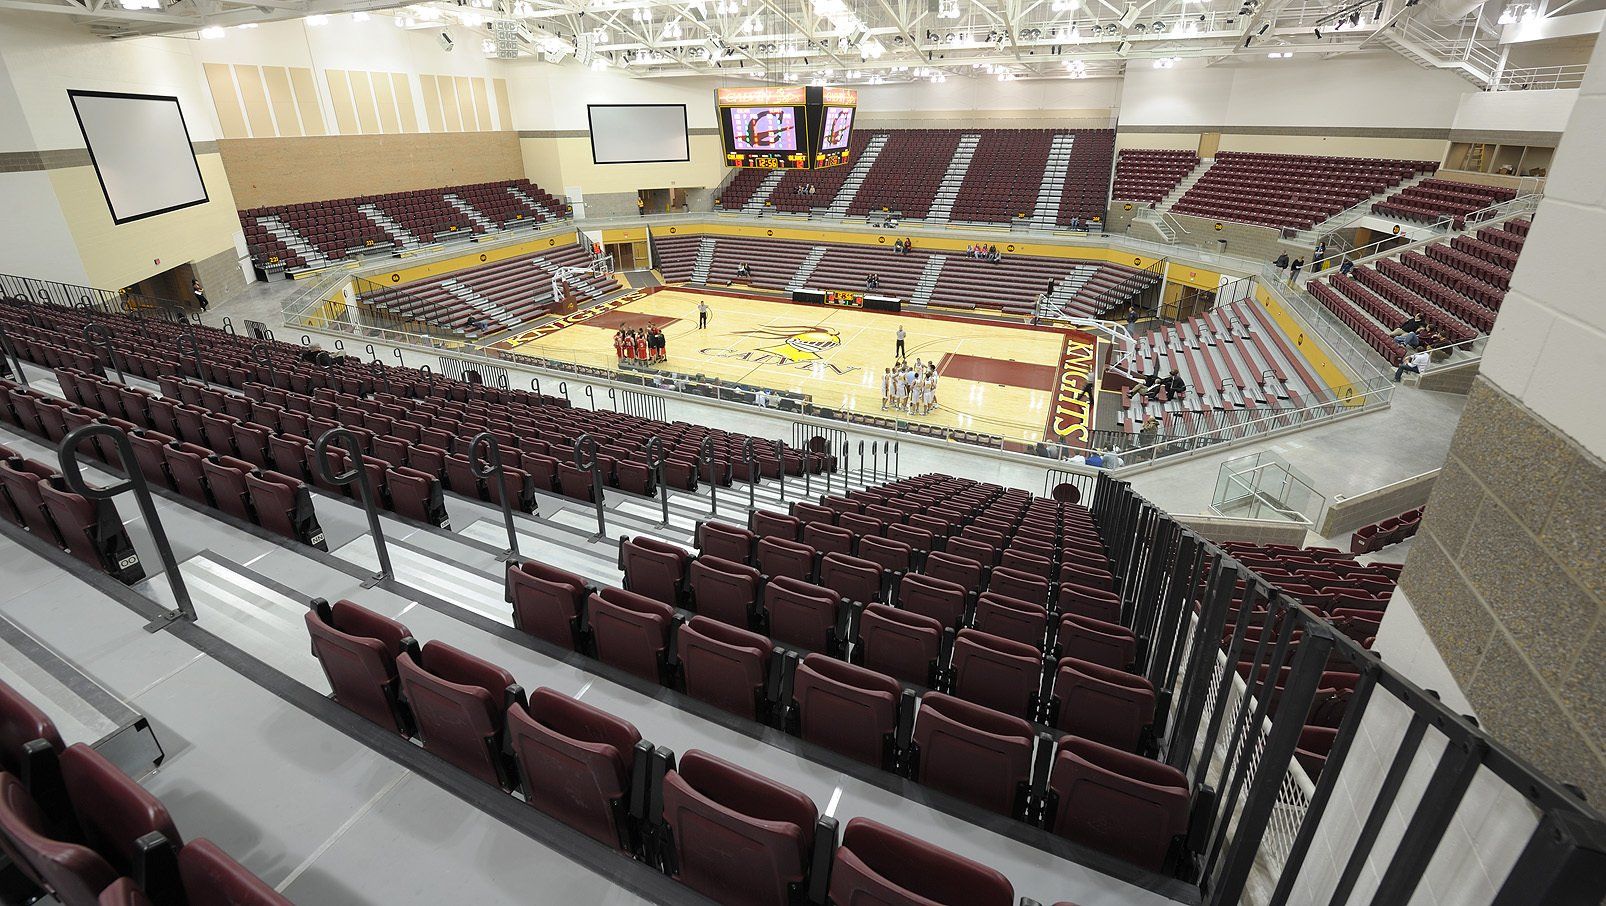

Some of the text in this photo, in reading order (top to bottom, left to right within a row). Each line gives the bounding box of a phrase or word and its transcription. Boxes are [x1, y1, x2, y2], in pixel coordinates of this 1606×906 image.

[758, 159, 777, 168] 12:56
[506, 291, 648, 347] KNIGHTS
[1053, 339, 1094, 443] KNIGHTS
